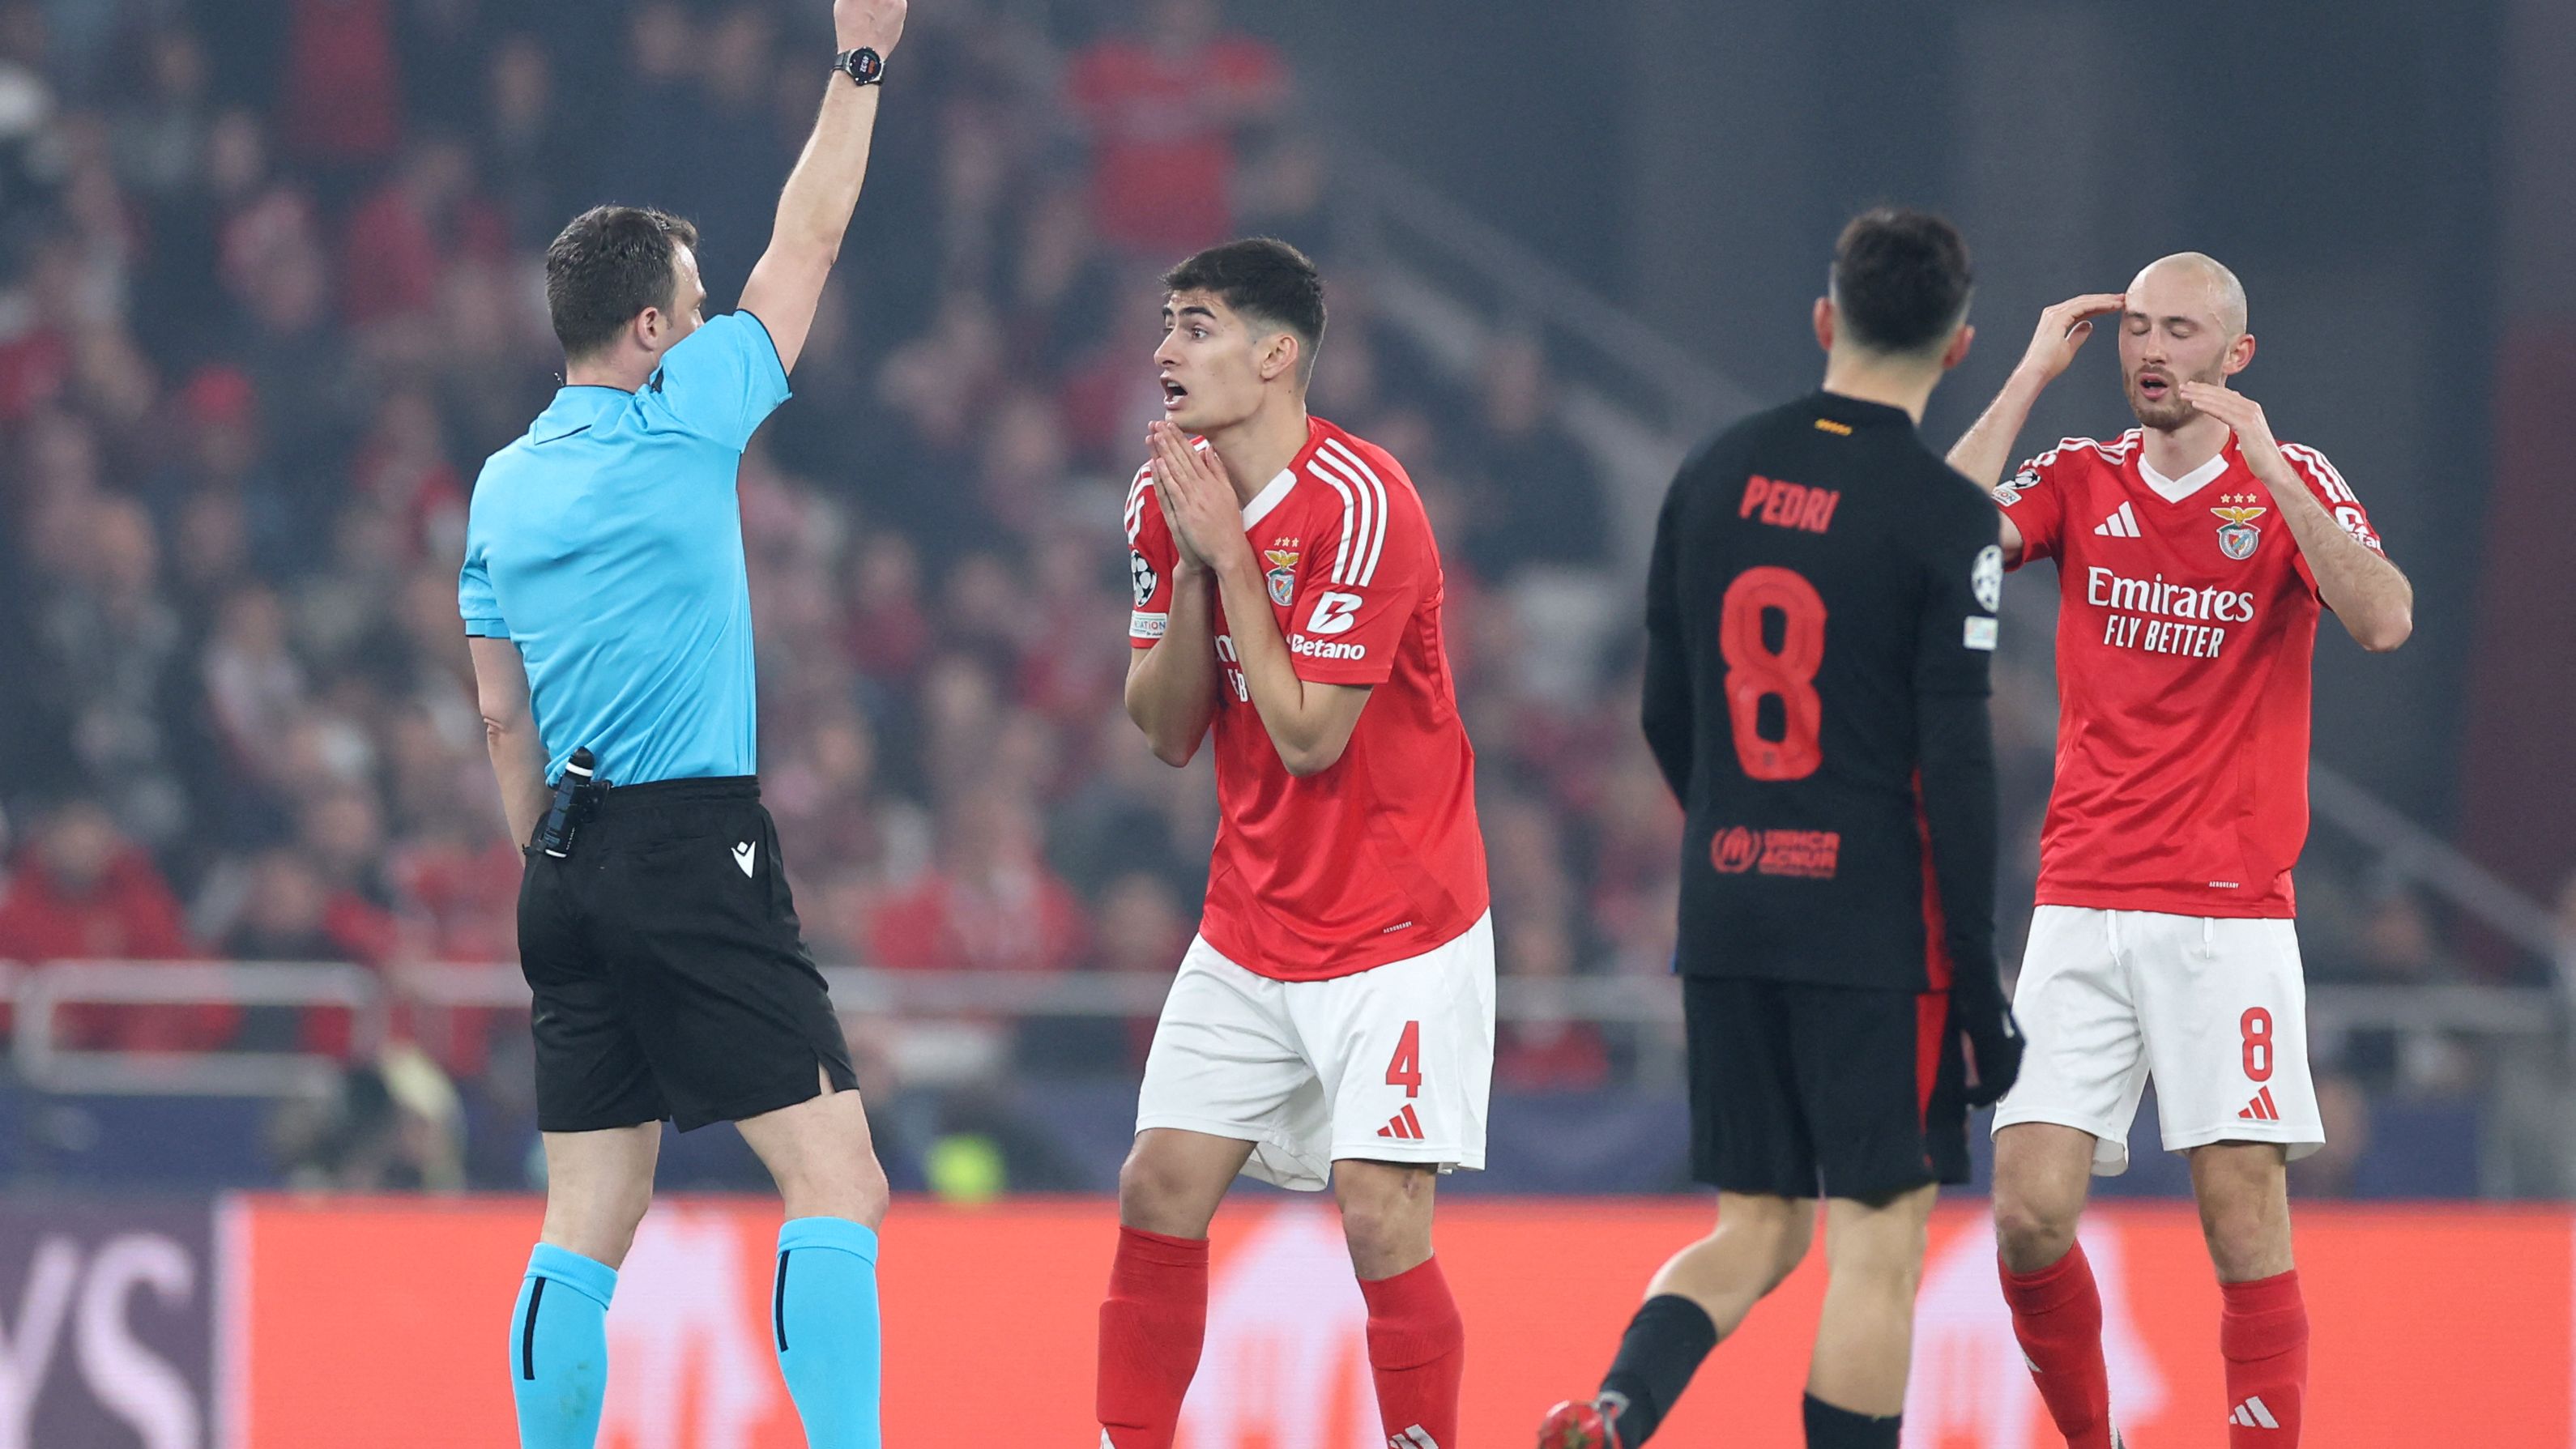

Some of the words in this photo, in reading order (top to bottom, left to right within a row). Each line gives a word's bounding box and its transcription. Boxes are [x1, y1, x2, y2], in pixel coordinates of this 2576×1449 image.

[1738, 475, 1840, 534] PEDRI
[2088, 565, 2254, 622] Emirates
[1291, 633, 1366, 660] Betano
[2104, 614, 2142, 648] FLY
[2144, 620, 2225, 658] BETTER
[1719, 566, 1828, 781] 8
[1385, 1020, 1422, 1098] 4
[2240, 1006, 2273, 1082] 8
